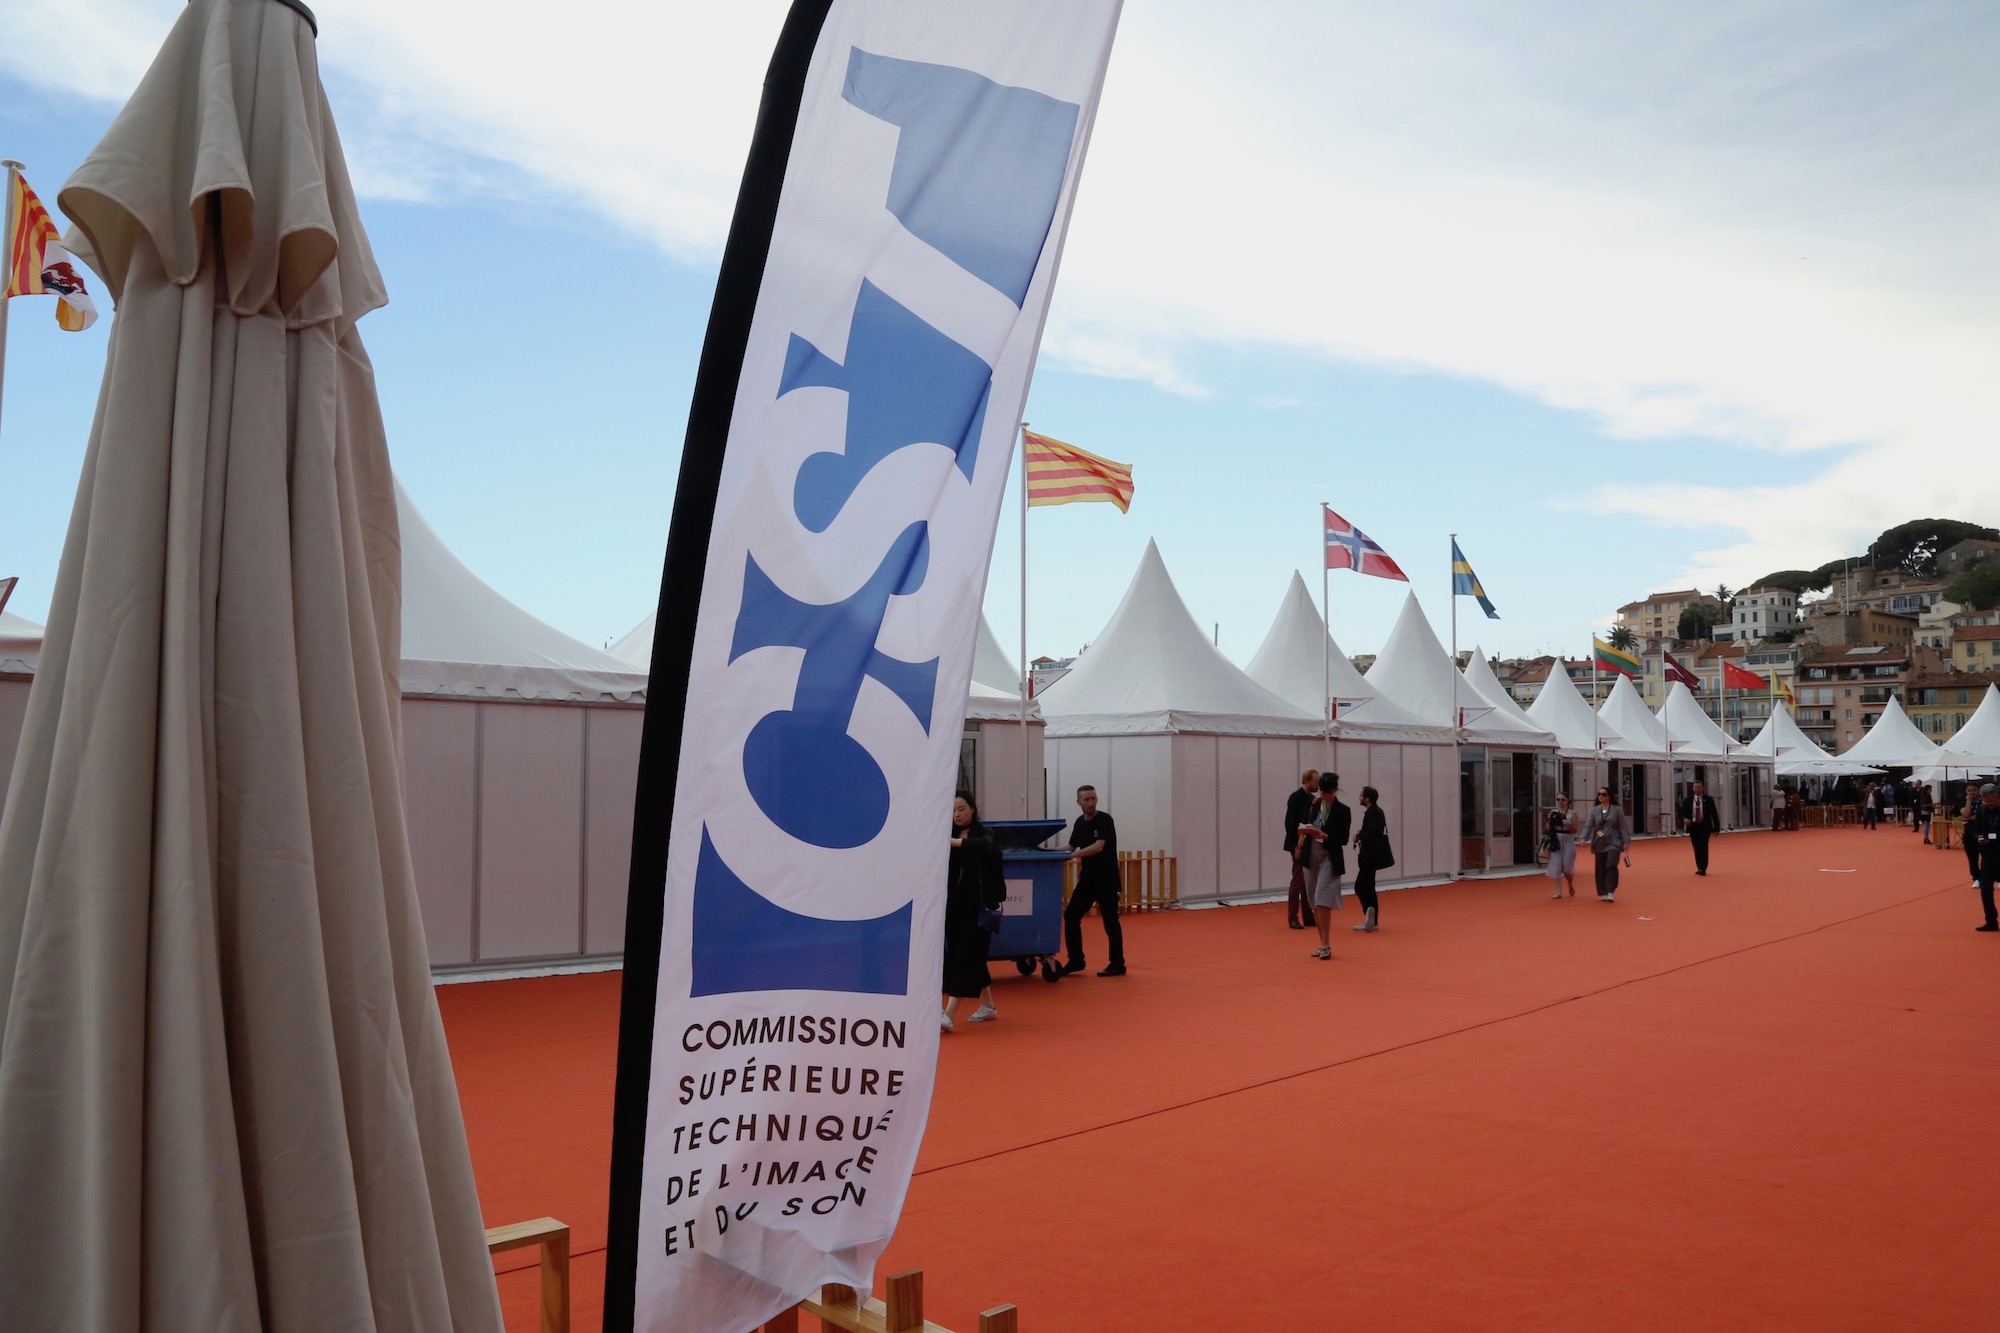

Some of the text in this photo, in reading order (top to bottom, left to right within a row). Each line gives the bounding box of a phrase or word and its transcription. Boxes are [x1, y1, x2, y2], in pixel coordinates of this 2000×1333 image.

[698, 94, 1022, 922] CST
[682, 1015, 906, 1053] COMMISSION
[679, 1057, 904, 1105] SUPÉRIEURE
[673, 1109, 894, 1155] TECHNIQUE
[667, 1169, 702, 1206] DE
[665, 1180, 867, 1257] ET DU SON
